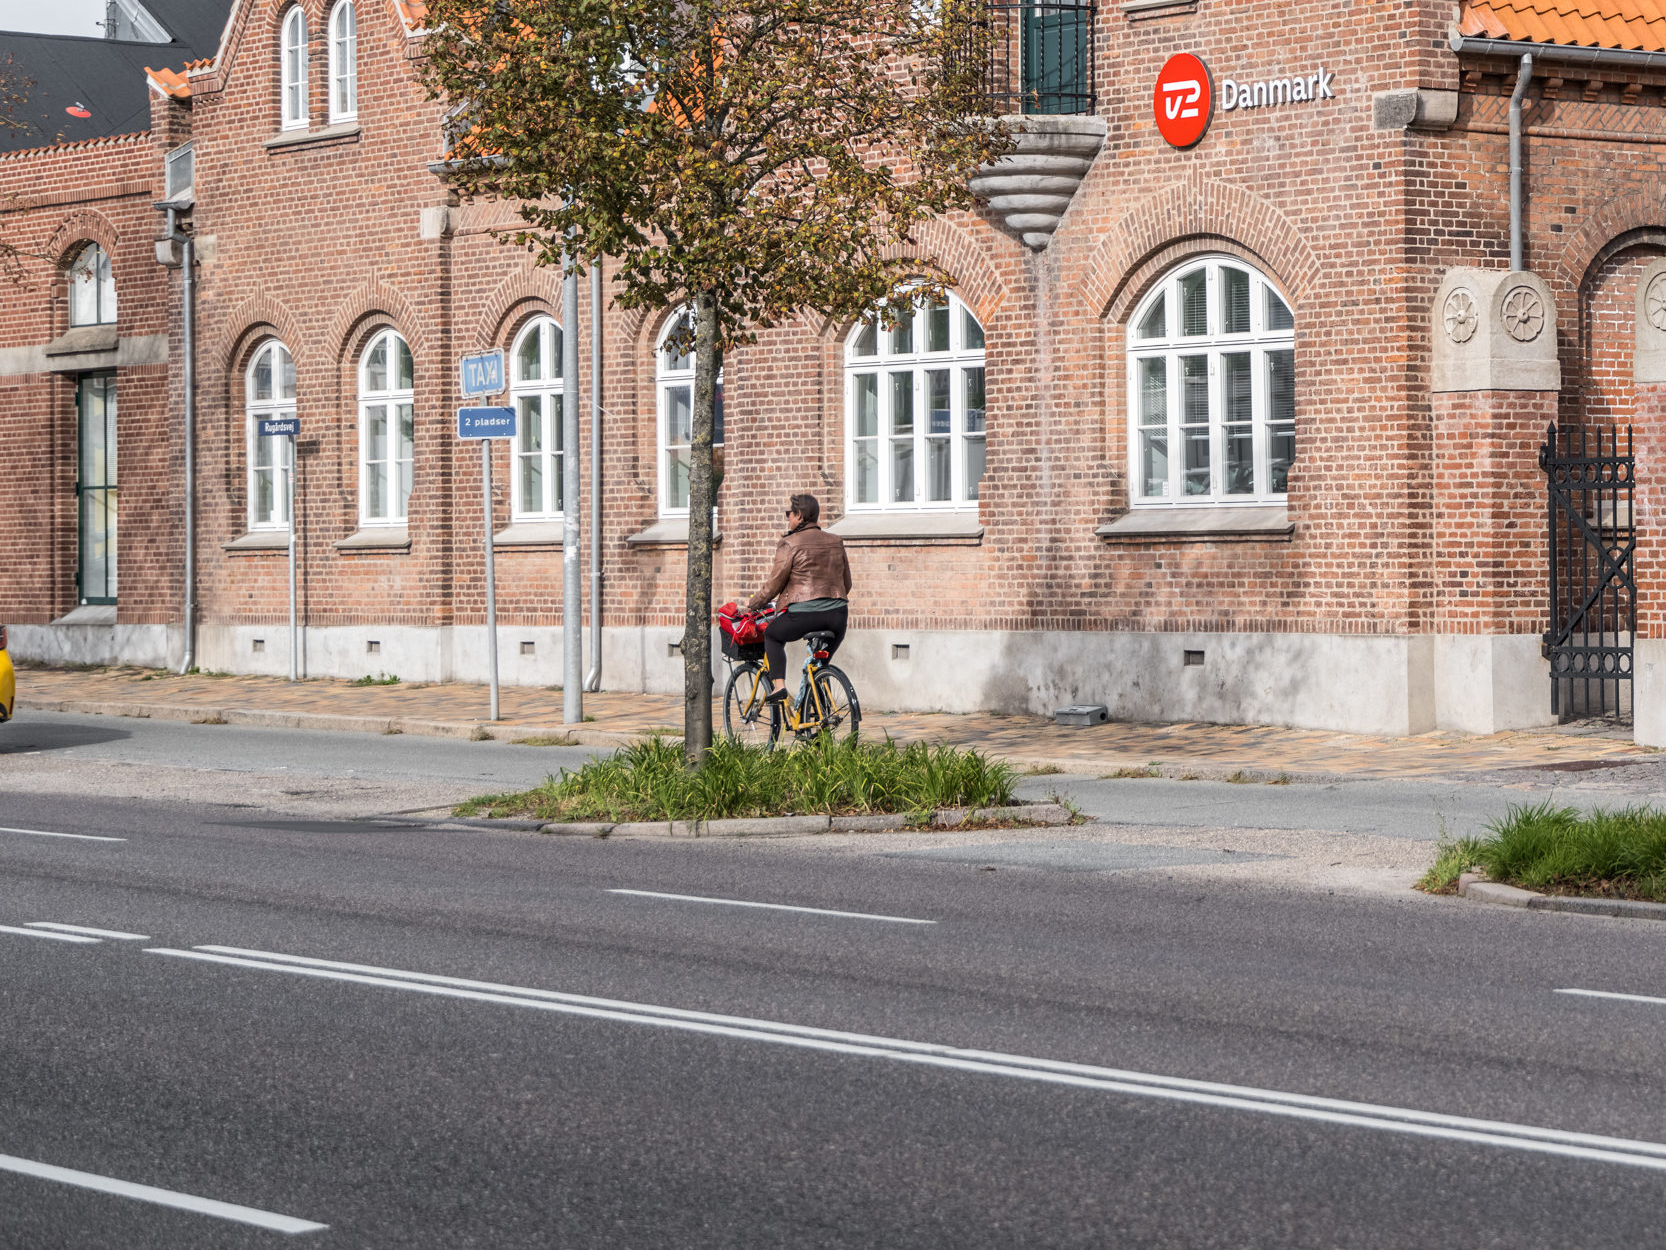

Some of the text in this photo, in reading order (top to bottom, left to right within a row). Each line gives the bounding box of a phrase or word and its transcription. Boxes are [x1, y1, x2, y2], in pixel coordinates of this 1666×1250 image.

[1222, 66, 1336, 111] Danmark
[468, 360, 498, 387] TAXI
[264, 421, 295, 434] Rugårdsvej
[465, 417, 511, 427] 2 pladser
